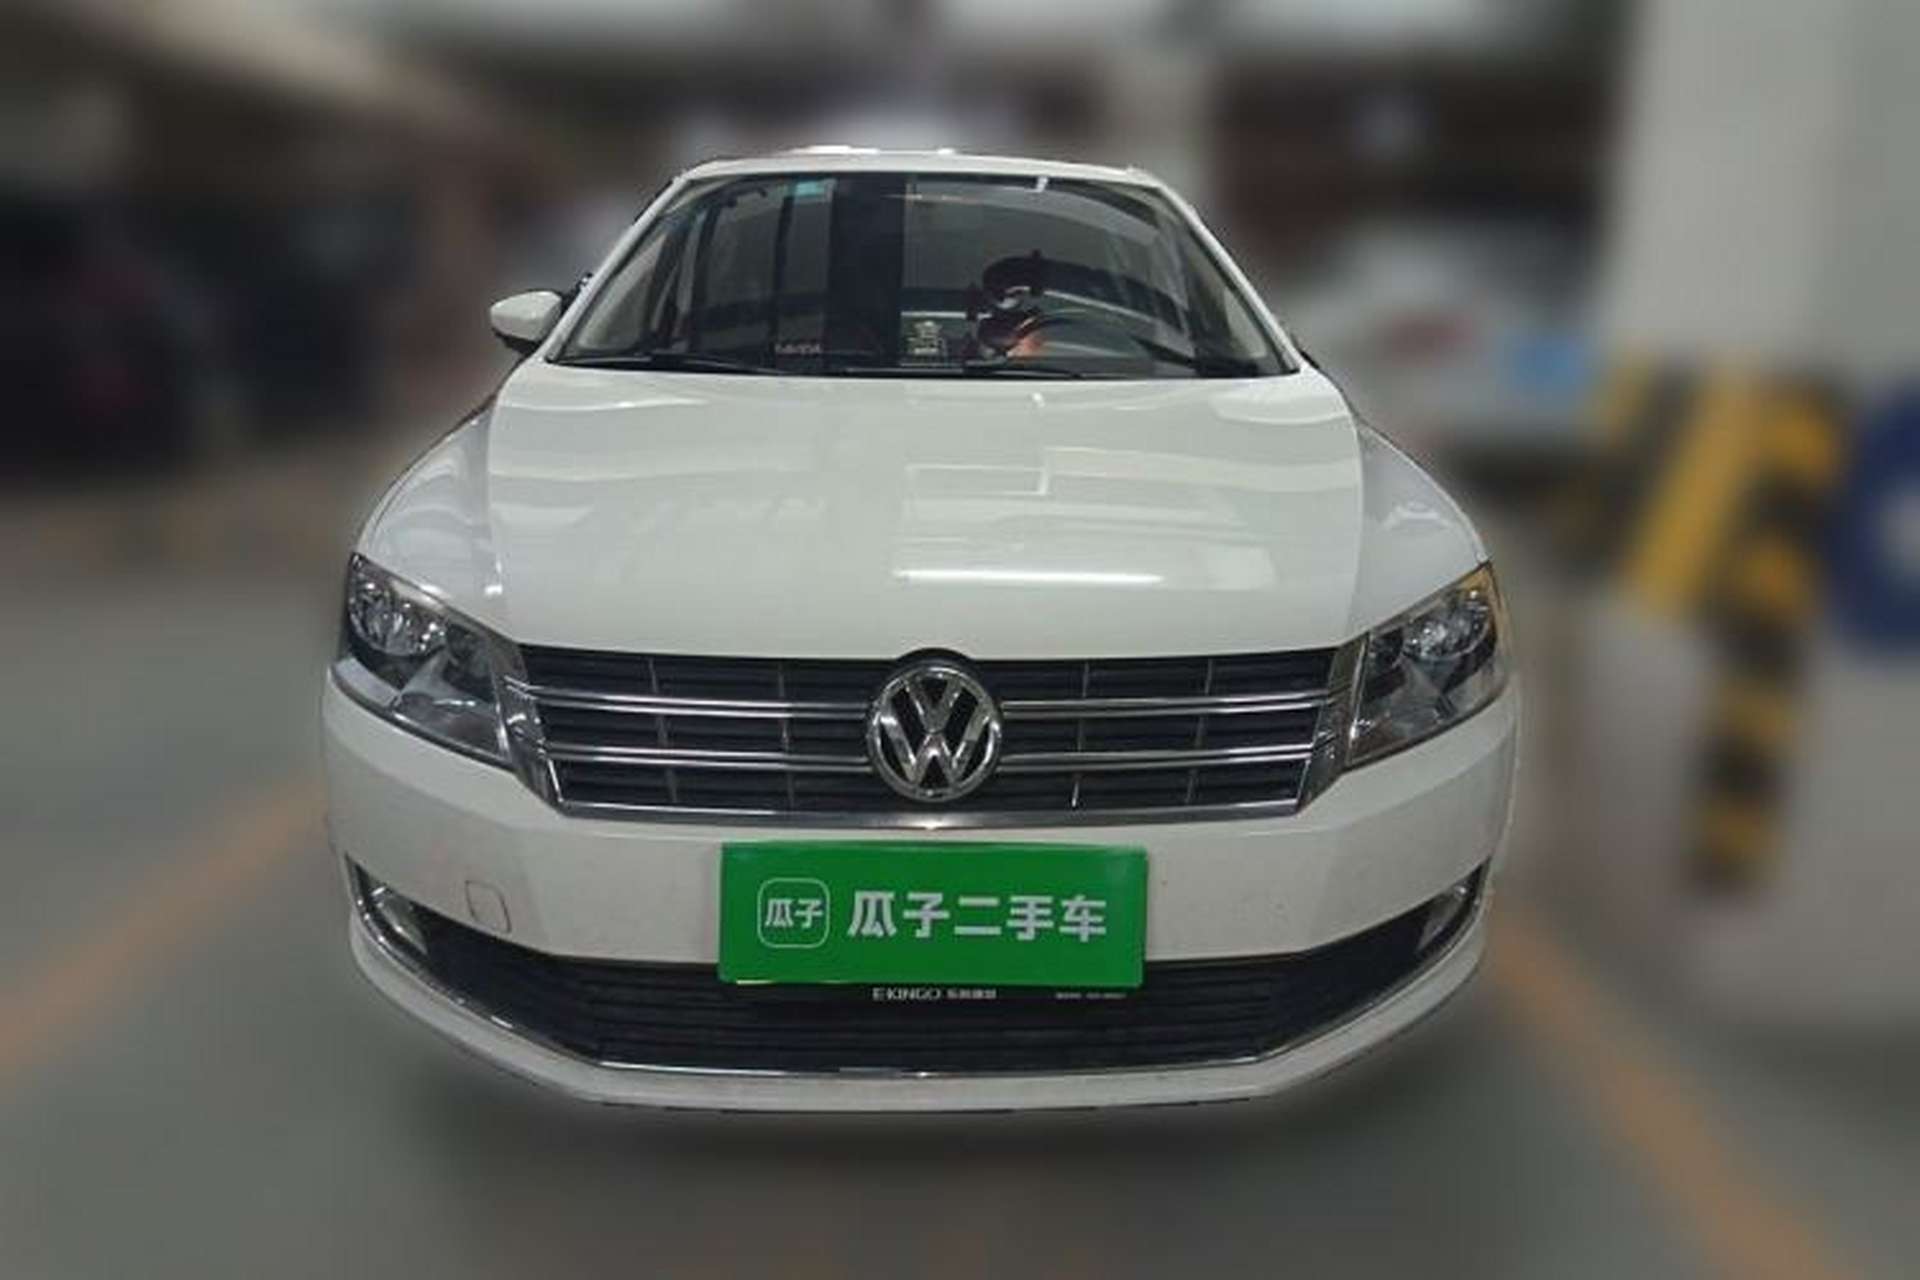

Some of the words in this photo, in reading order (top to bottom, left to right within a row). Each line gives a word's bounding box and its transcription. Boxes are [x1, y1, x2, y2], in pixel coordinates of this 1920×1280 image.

[766, 899, 822, 927] 瓜子
[848, 891, 1106, 941] 瓜子二手车
